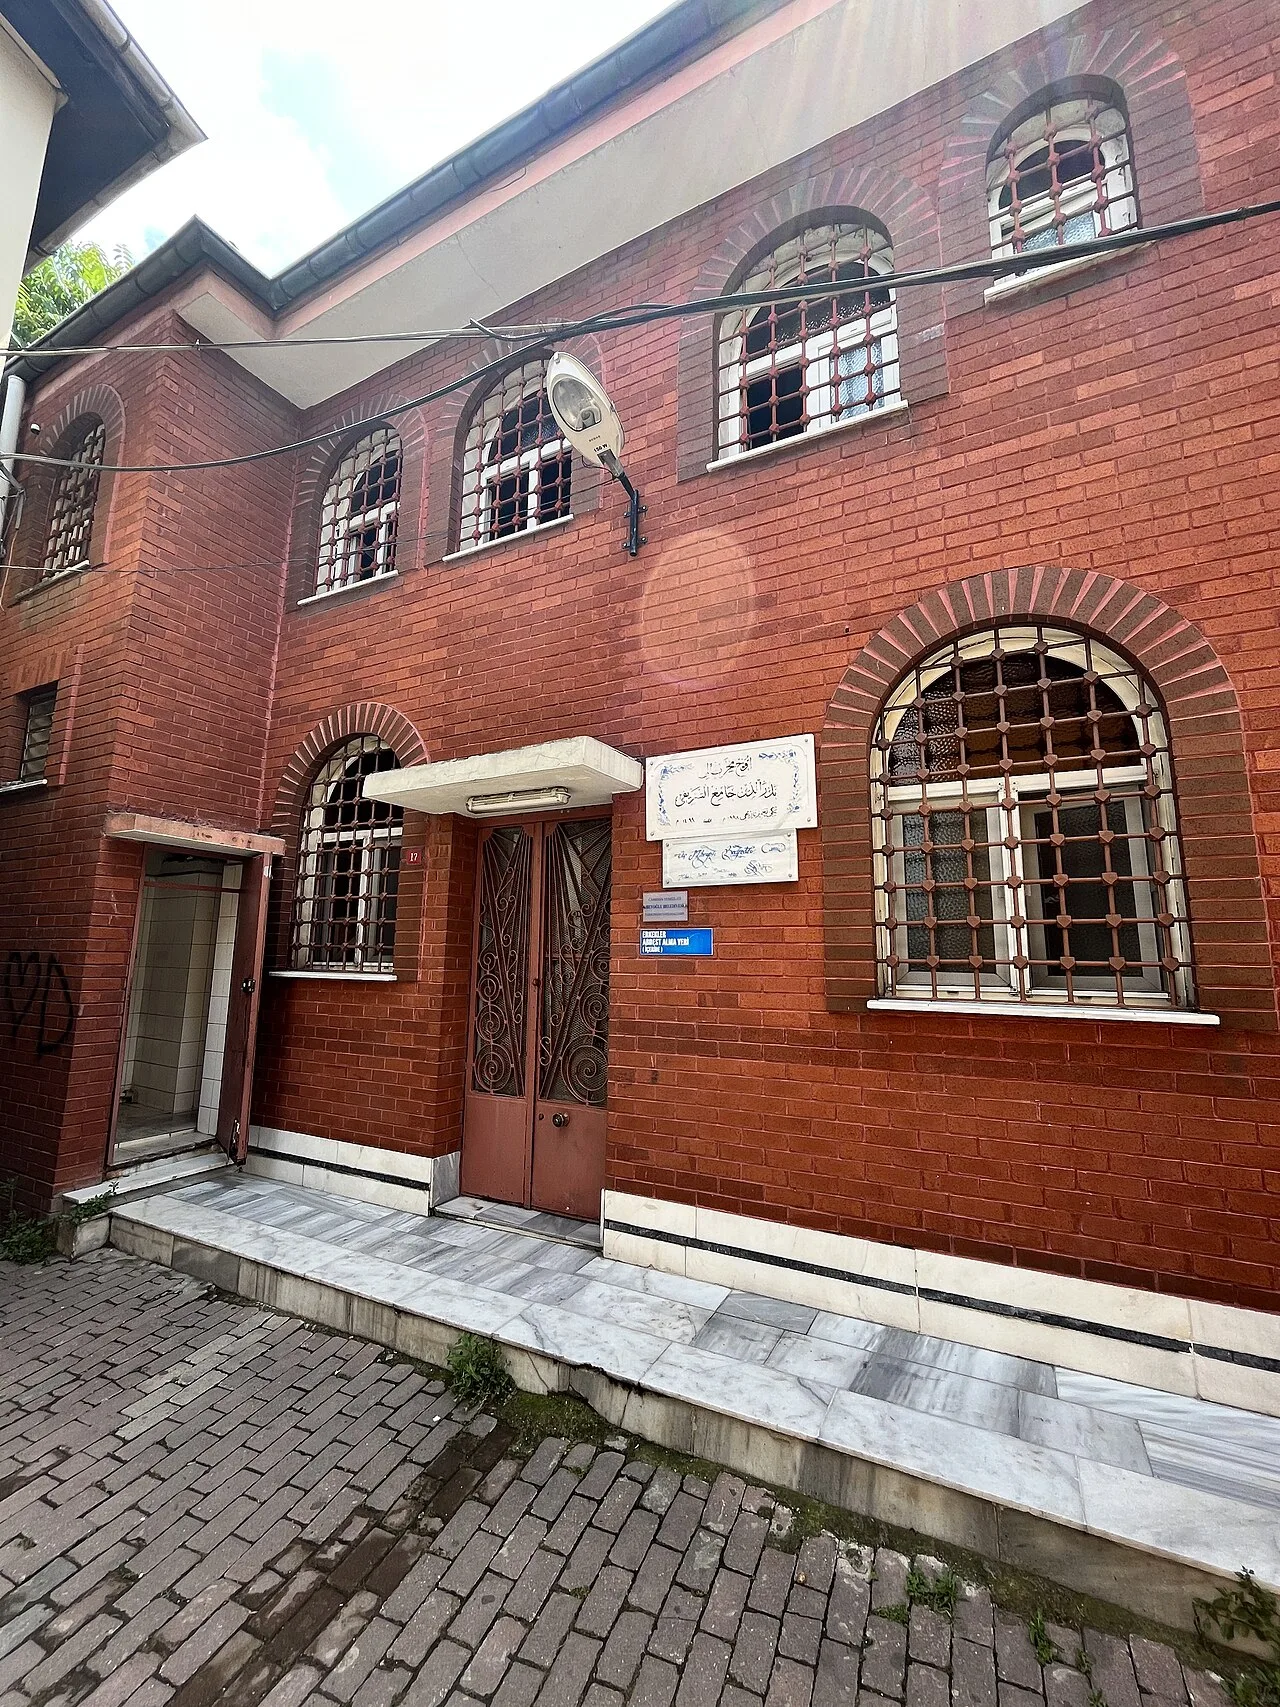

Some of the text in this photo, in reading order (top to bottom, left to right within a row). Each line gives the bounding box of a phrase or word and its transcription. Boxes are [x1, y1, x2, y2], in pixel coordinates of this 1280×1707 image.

[410, 852, 418, 862] 17
[642, 930, 667, 938] ERKEKLER
[642, 936, 690, 946] ABDEST ALMA YERİ
